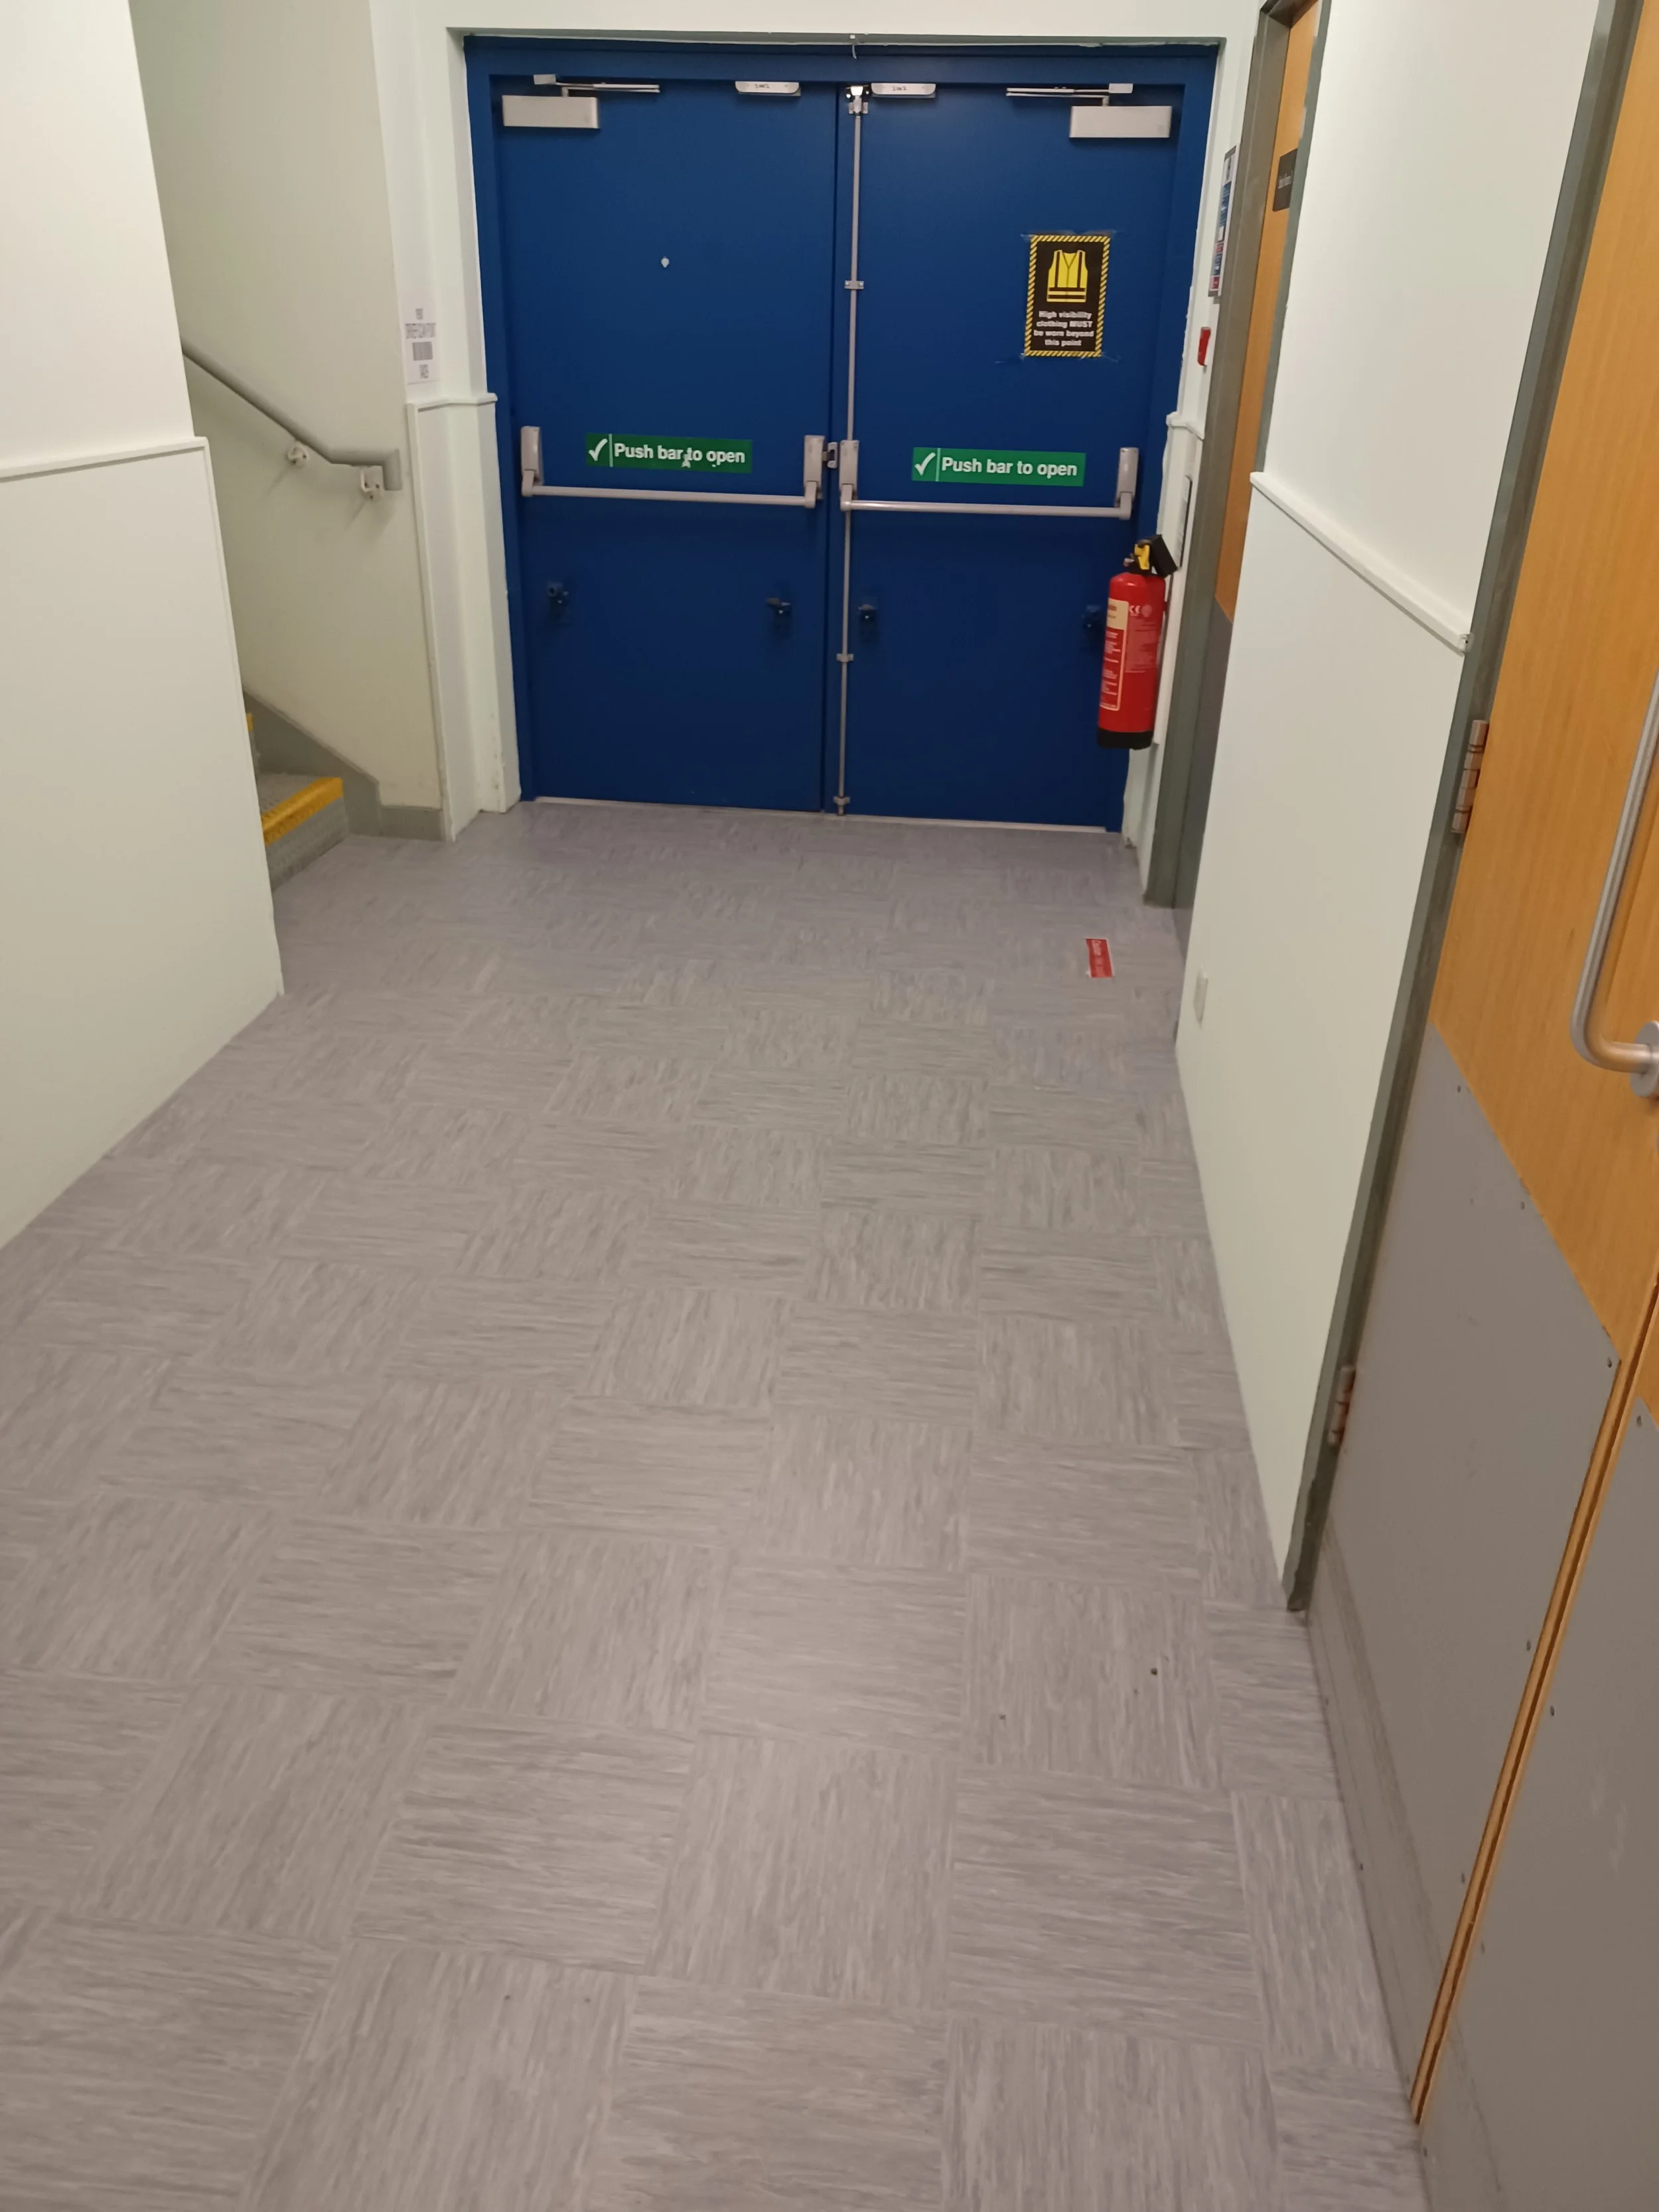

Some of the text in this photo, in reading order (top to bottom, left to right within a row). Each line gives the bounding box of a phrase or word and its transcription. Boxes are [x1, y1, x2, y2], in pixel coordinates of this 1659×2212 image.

[614, 443, 745, 465] Push bar to open
[942, 457, 1078, 479] Push bar to open
